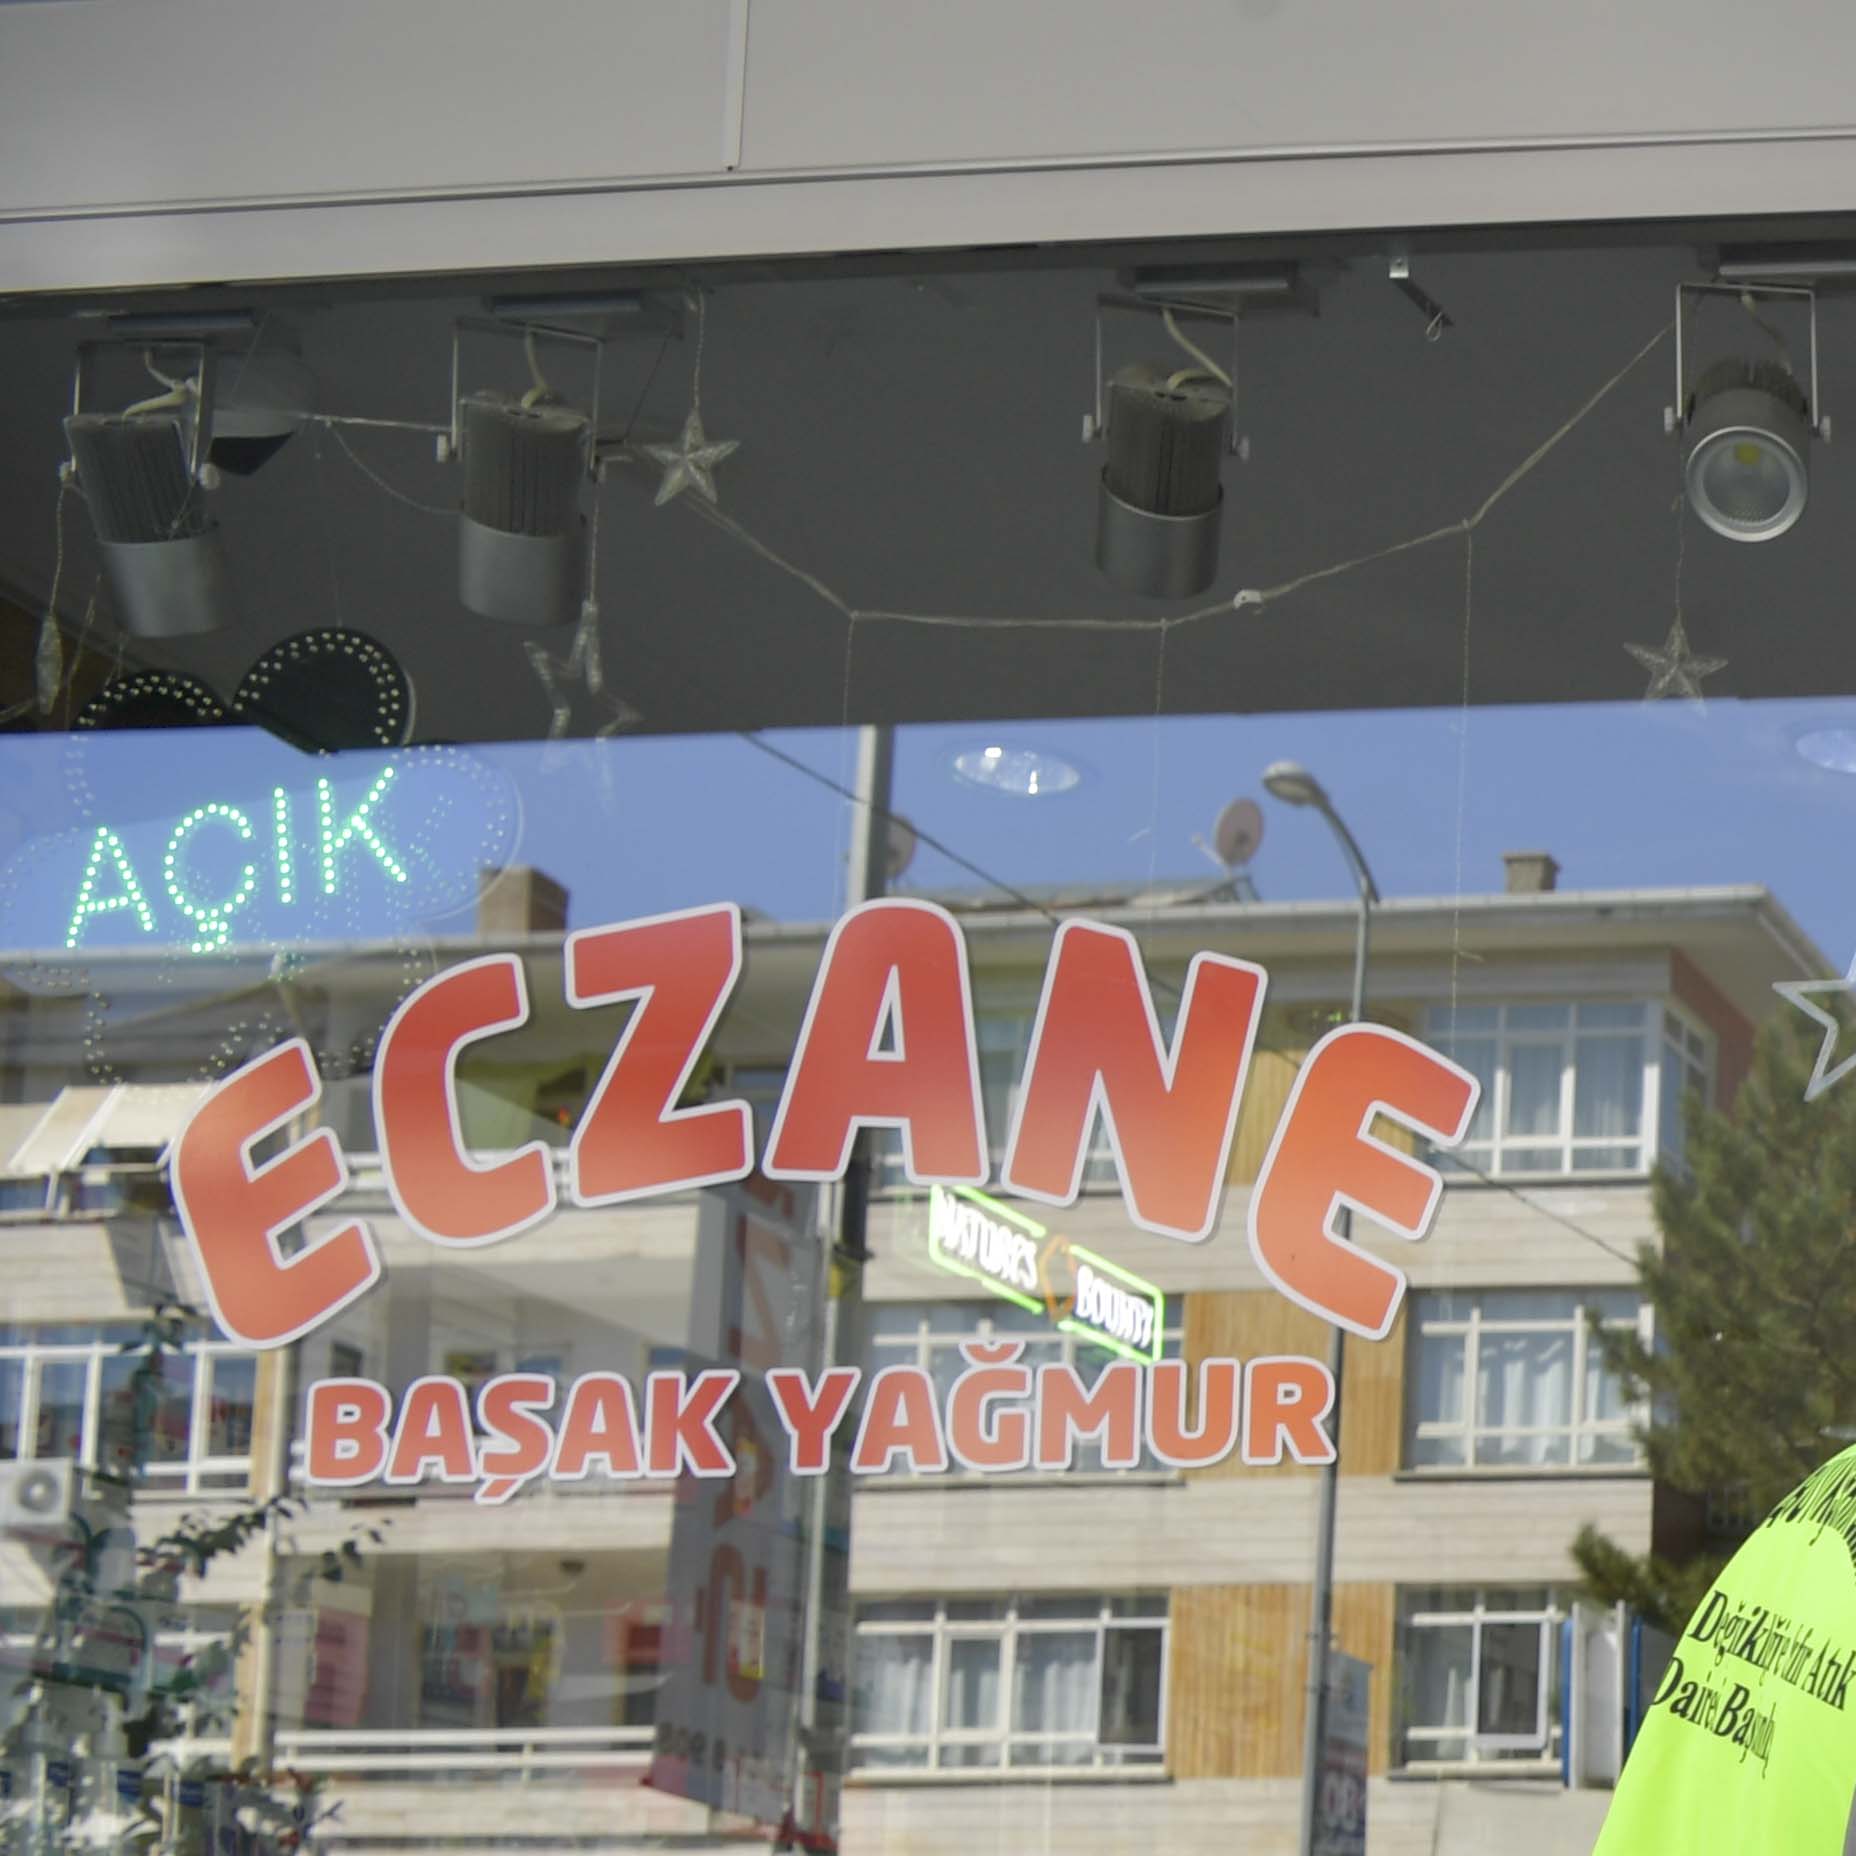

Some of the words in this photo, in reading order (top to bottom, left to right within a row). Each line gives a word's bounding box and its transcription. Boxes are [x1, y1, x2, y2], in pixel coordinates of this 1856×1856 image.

[66, 767, 407, 953] AÇIK
[171, 898, 1481, 1350] ECZANE
[304, 1369, 741, 1503] BAŞAK
[765, 1341, 1337, 1476] YAĞMUR
